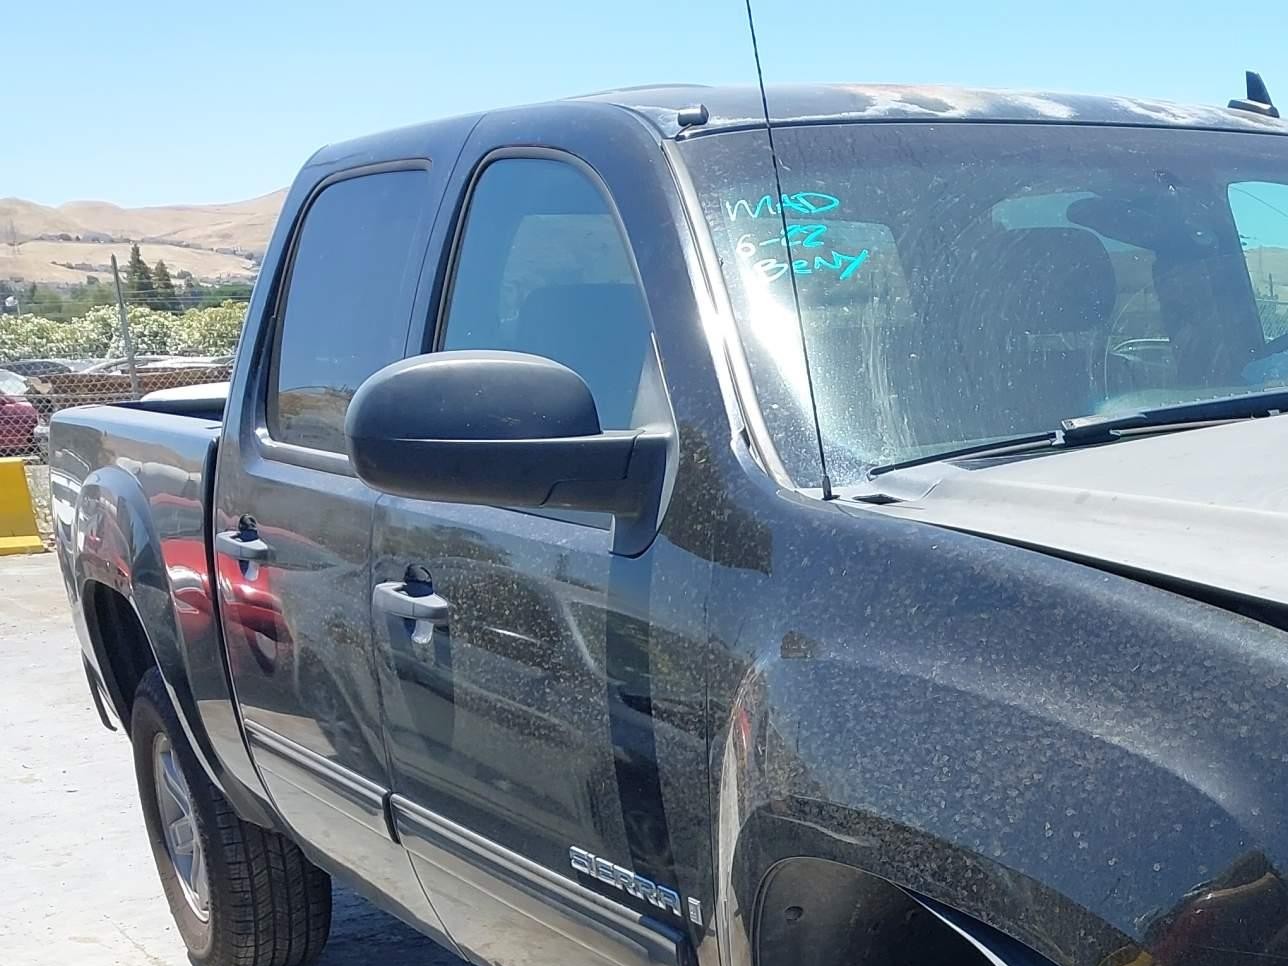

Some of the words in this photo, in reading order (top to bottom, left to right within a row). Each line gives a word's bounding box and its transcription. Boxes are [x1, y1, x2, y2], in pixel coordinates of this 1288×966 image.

[725, 191, 840, 222] MAD
[736, 223, 828, 257] 6-22
[568, 845, 683, 917] SIERRA
